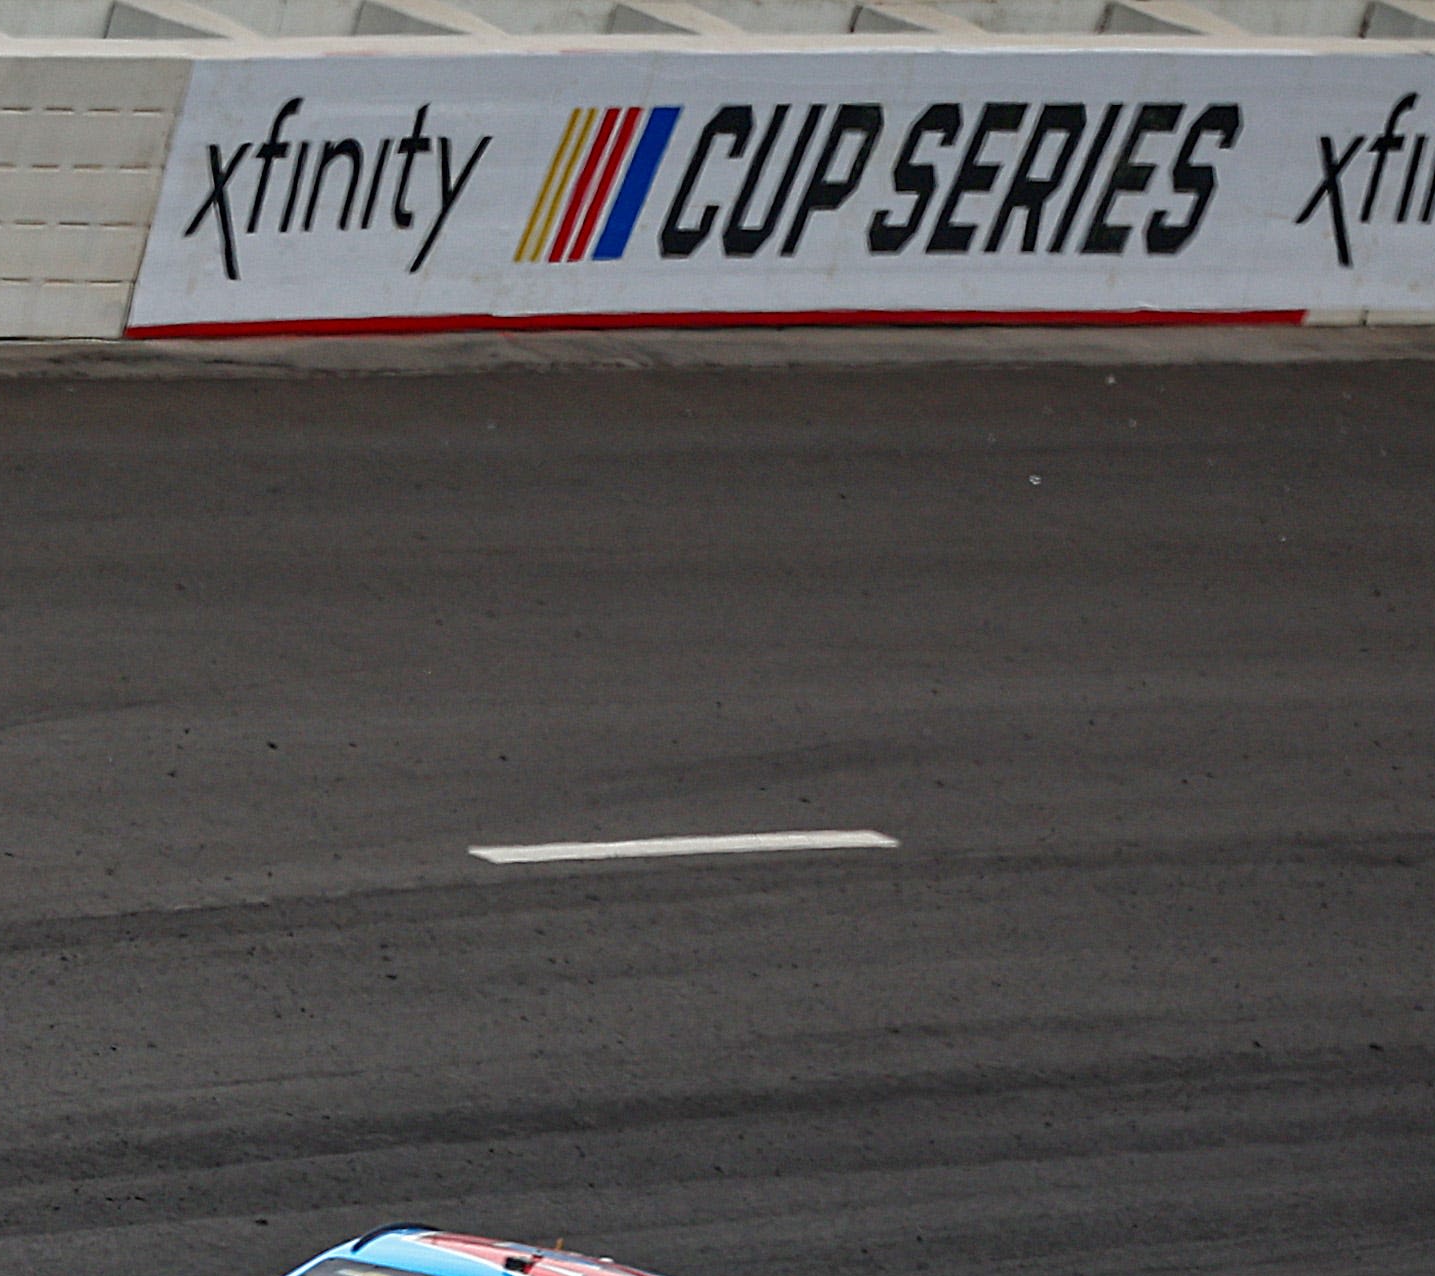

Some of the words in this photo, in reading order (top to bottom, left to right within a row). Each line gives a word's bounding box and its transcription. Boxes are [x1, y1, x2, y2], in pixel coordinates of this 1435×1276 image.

[185, 96, 493, 282] xfinity
[658, 104, 885, 259] CUP
[867, 103, 1243, 257] SERIES
